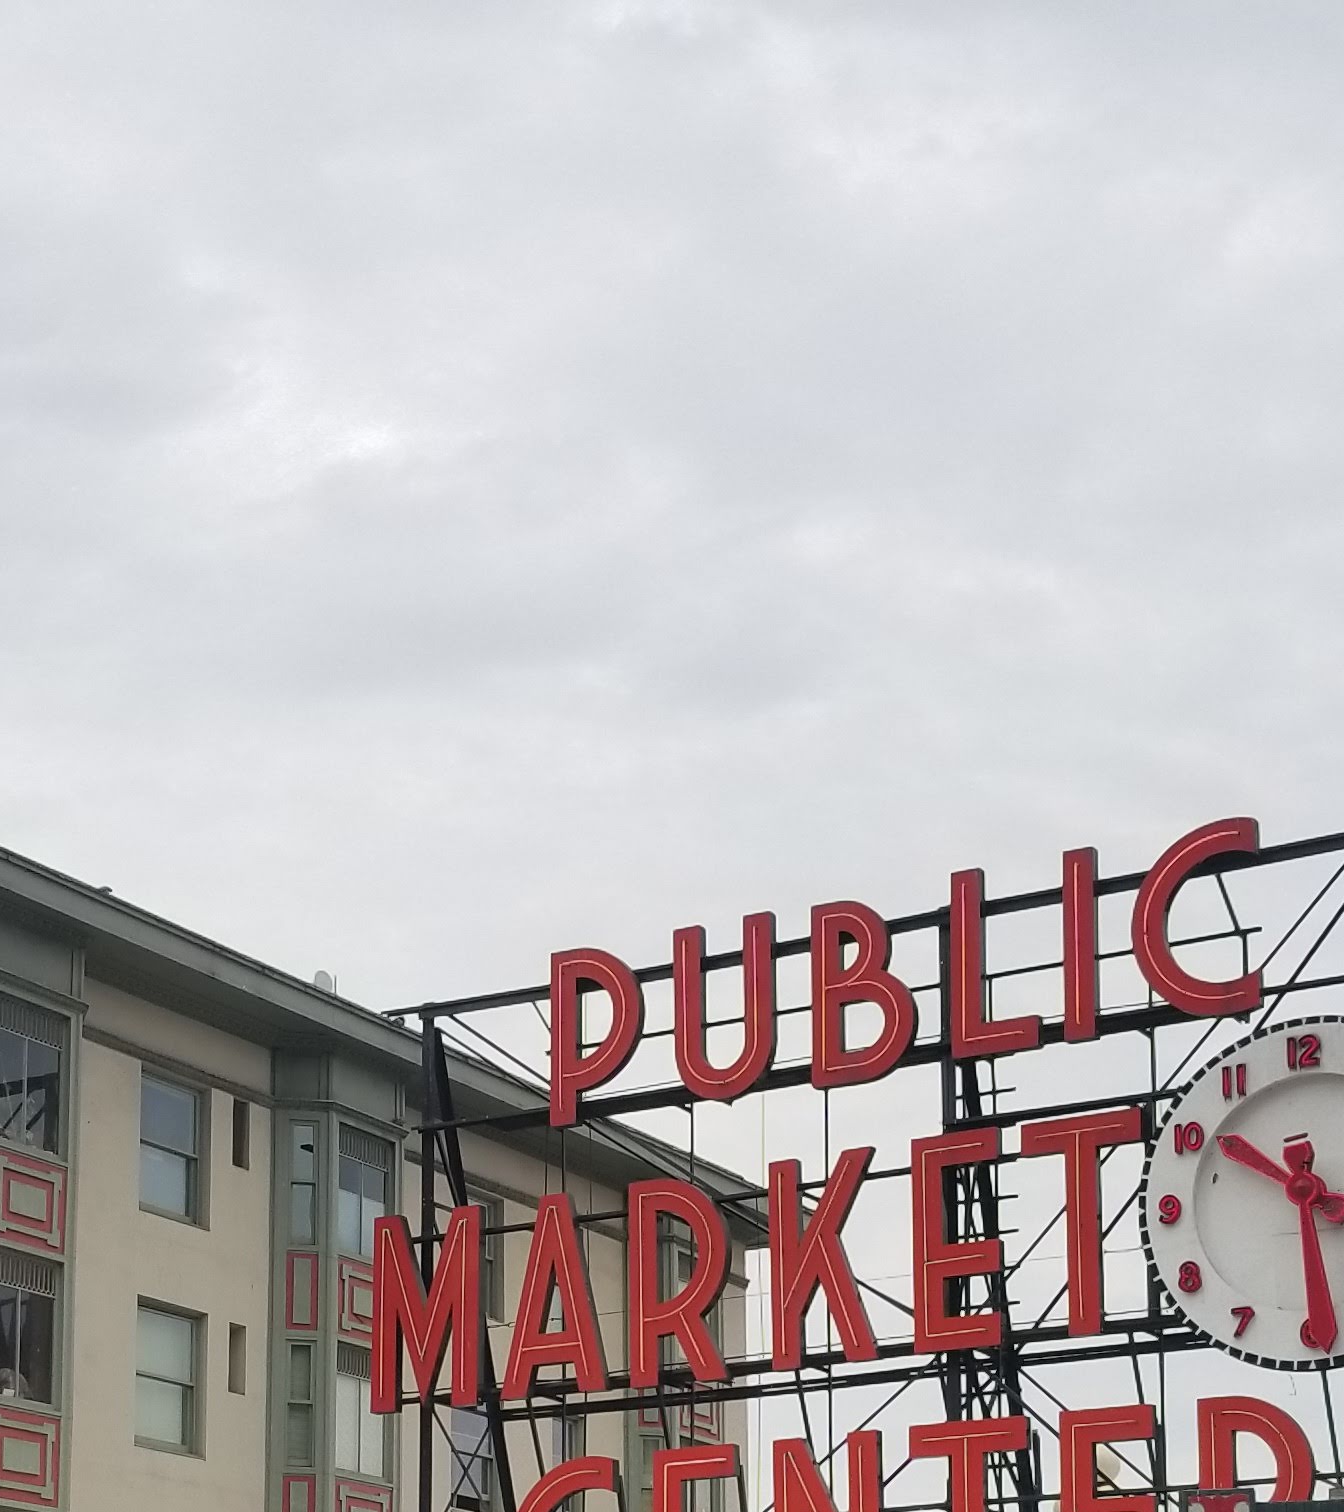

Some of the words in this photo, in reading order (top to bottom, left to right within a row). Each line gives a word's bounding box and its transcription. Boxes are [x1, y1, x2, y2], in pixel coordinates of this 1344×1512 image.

[550, 816, 1263, 1128] PUBLIC
[1286, 1034, 1321, 1070] 12
[1221, 1063, 1247, 1098] 11
[1174, 1121, 1204, 1155] 10
[1158, 1194, 1182, 1225] 9
[371, 1104, 1146, 1414] MARKET
[1177, 1260, 1202, 1293] 8
[1231, 1306, 1255, 1338] 7
